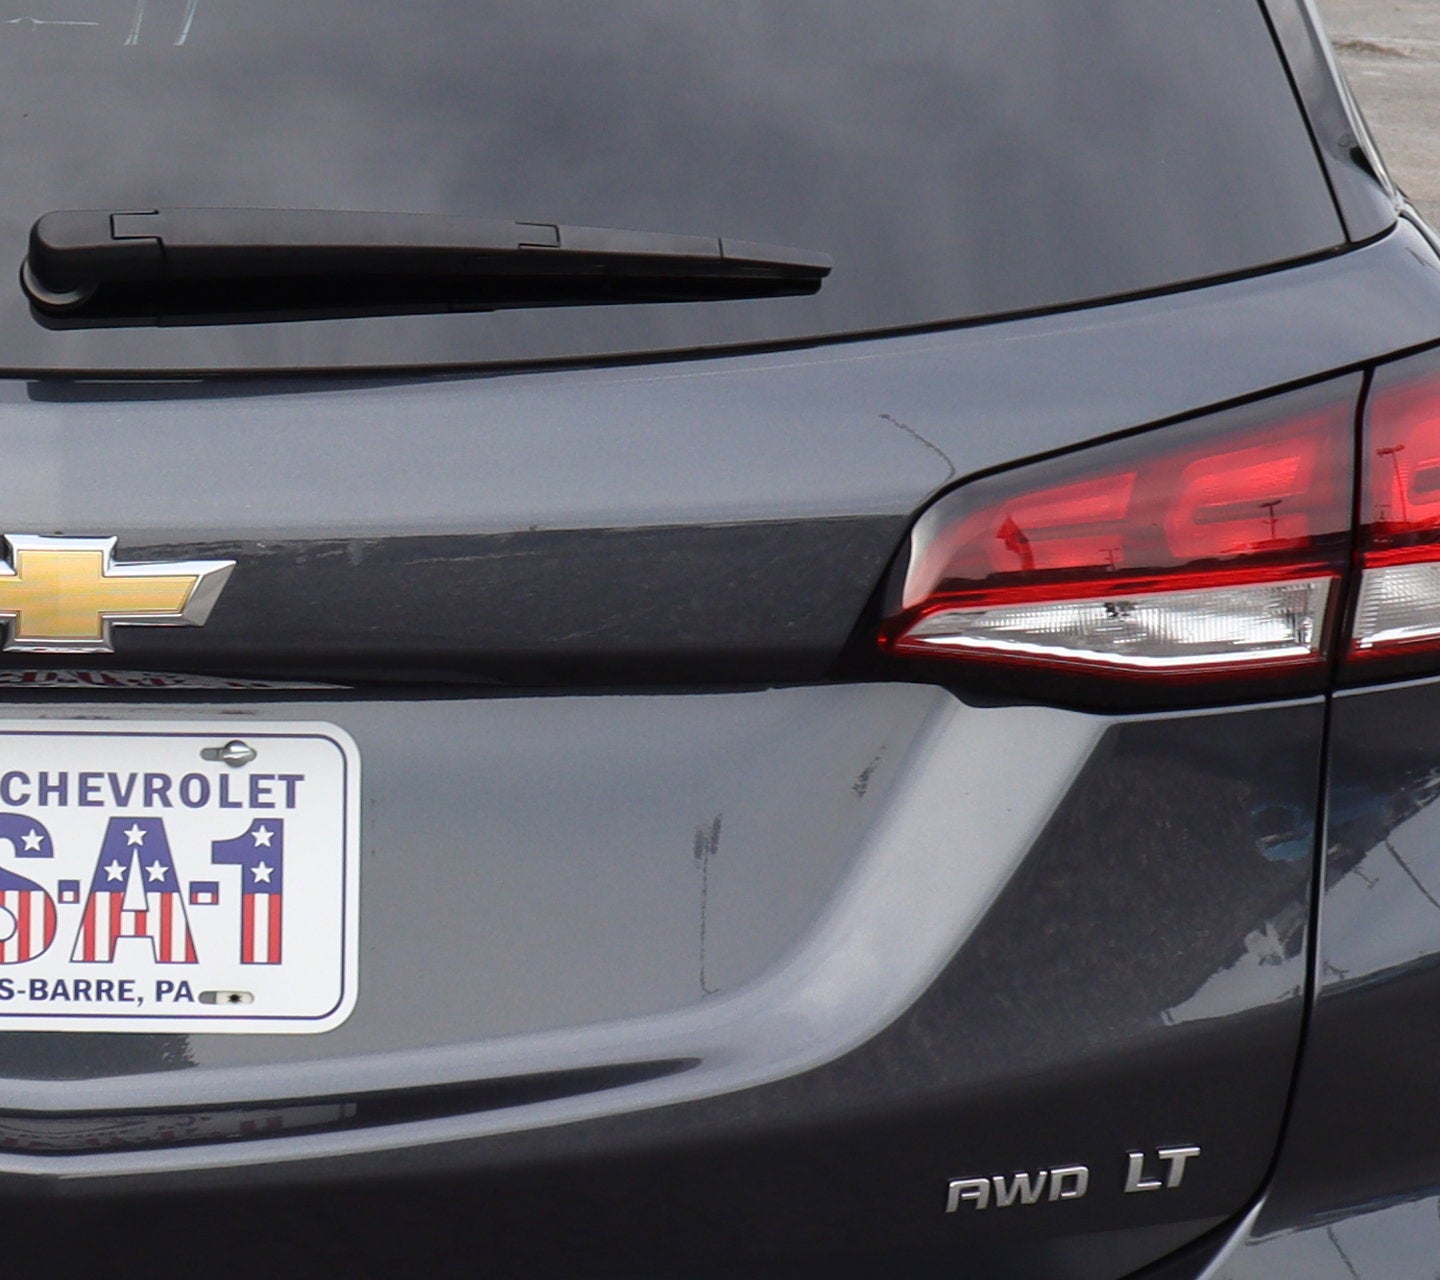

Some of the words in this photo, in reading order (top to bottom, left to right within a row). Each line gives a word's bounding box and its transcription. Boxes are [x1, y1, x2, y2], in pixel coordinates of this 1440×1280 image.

[154, 979, 196, 1003] PA
[945, 1165, 1090, 1213] AWD
[1124, 1147, 1201, 1193] LT
